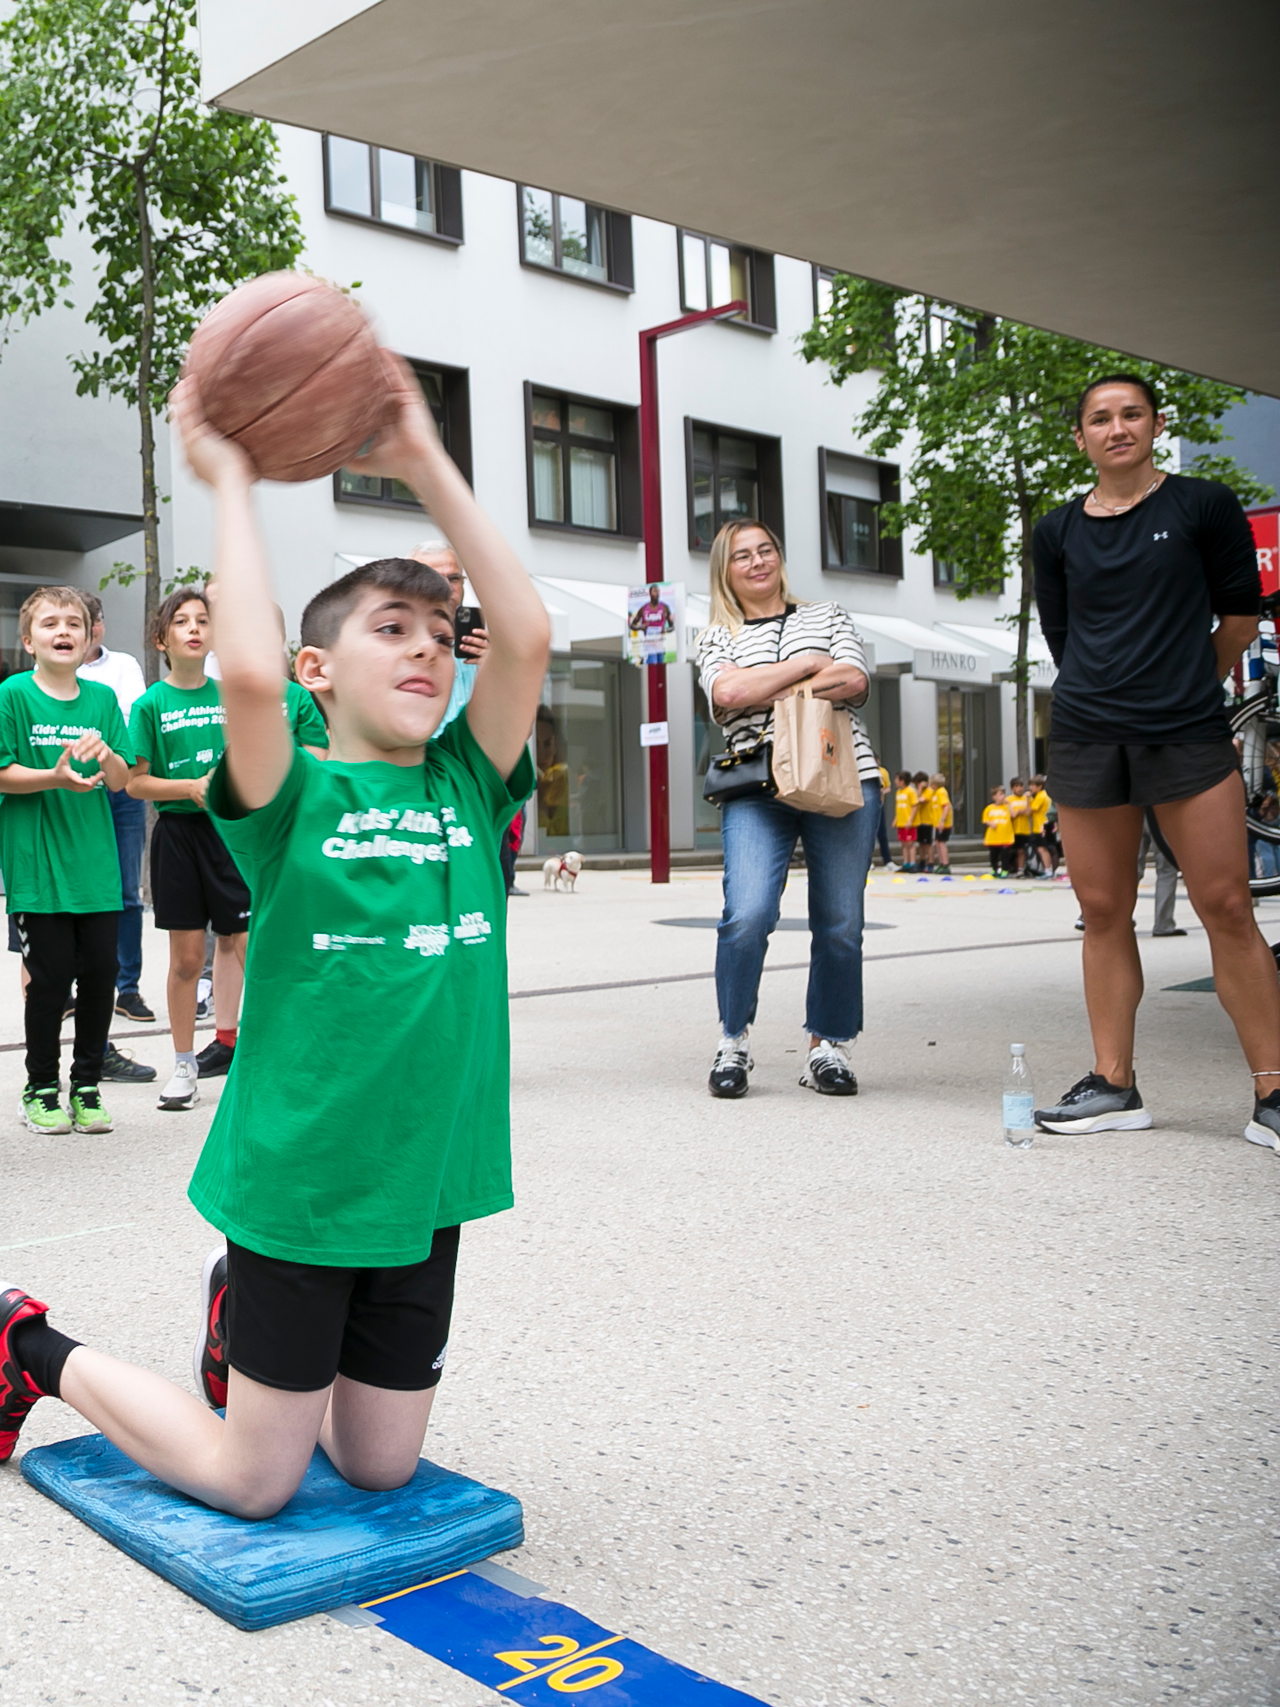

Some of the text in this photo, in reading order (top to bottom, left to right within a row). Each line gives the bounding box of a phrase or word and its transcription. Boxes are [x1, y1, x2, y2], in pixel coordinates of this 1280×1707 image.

[931, 652, 977, 672] HANRO
[161, 708, 187, 723] Kids'
[31, 724, 59, 735] Kids'
[161, 716, 210, 734] Challenge
[493, 1634, 625, 1693] 20
